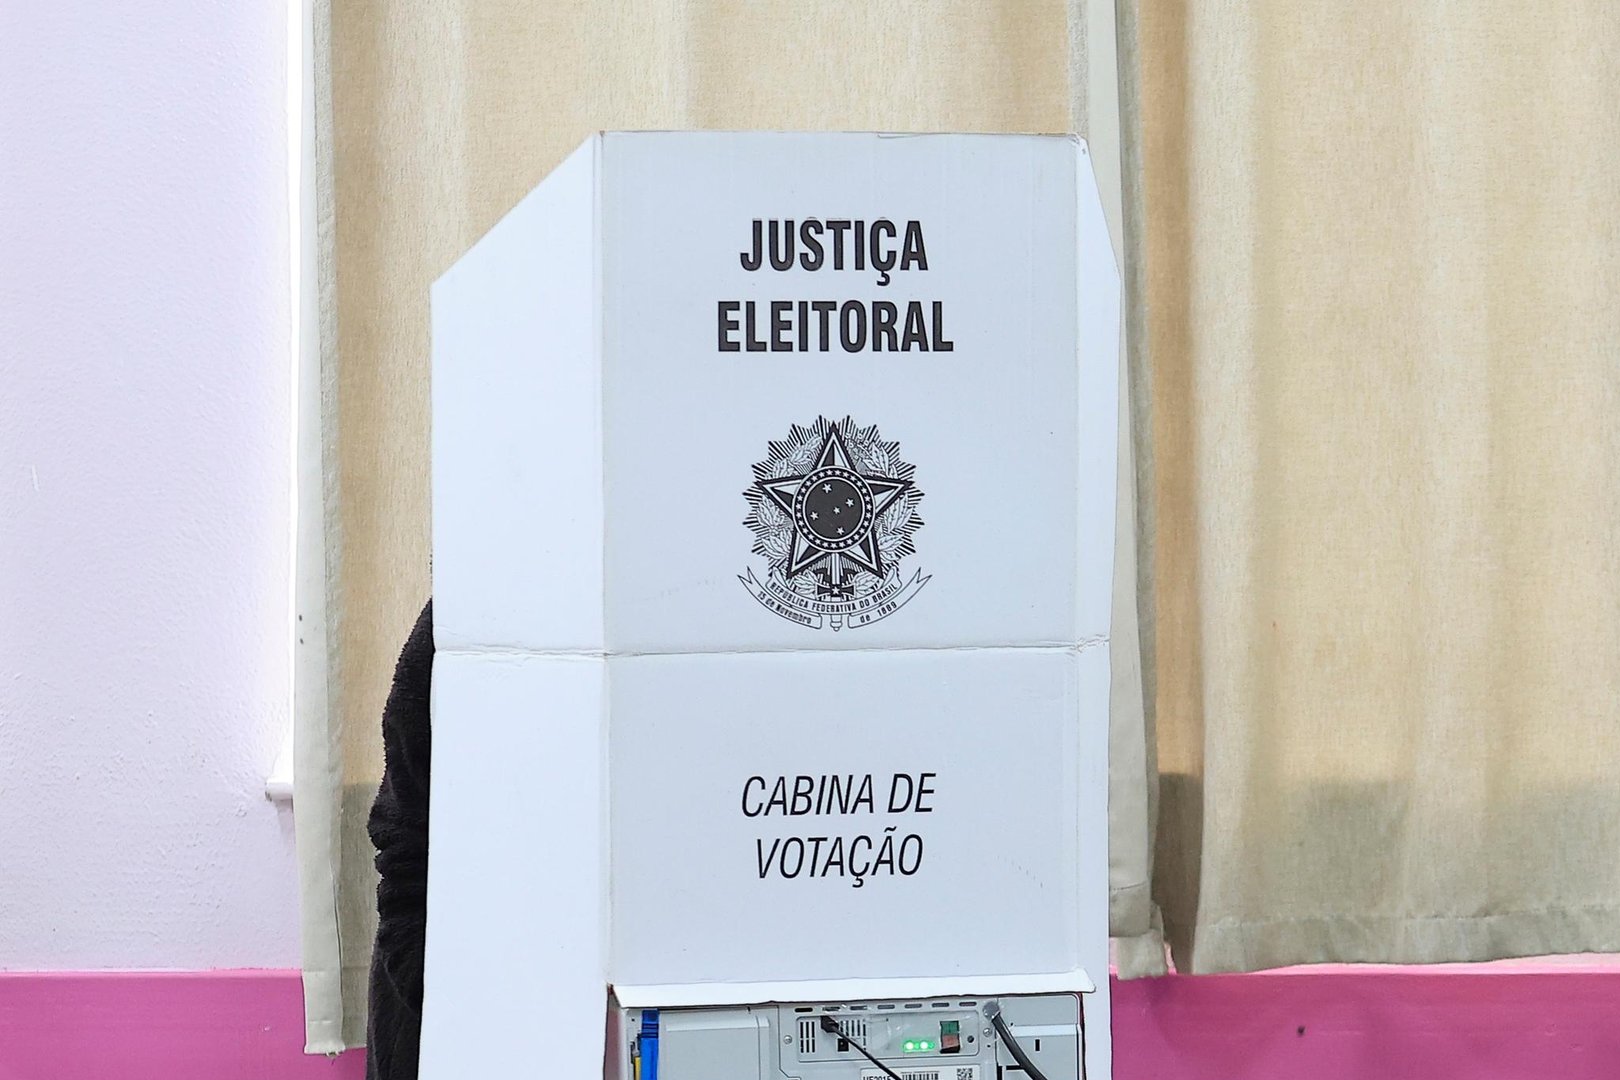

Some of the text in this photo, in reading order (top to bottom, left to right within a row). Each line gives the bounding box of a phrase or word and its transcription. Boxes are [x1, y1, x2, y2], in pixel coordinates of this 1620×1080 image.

[739, 218, 929, 286] JUSTIÇA
[717, 299, 954, 354] ELEITORAL
[811, 603, 857, 613] FEDERATIVA
[858, 598, 870, 609] DO
[871, 583, 898, 604] BRASIL
[859, 615, 870, 623] de
[741, 772, 937, 818] CABINA DE
[756, 825, 924, 889] VOTAÇÃO
